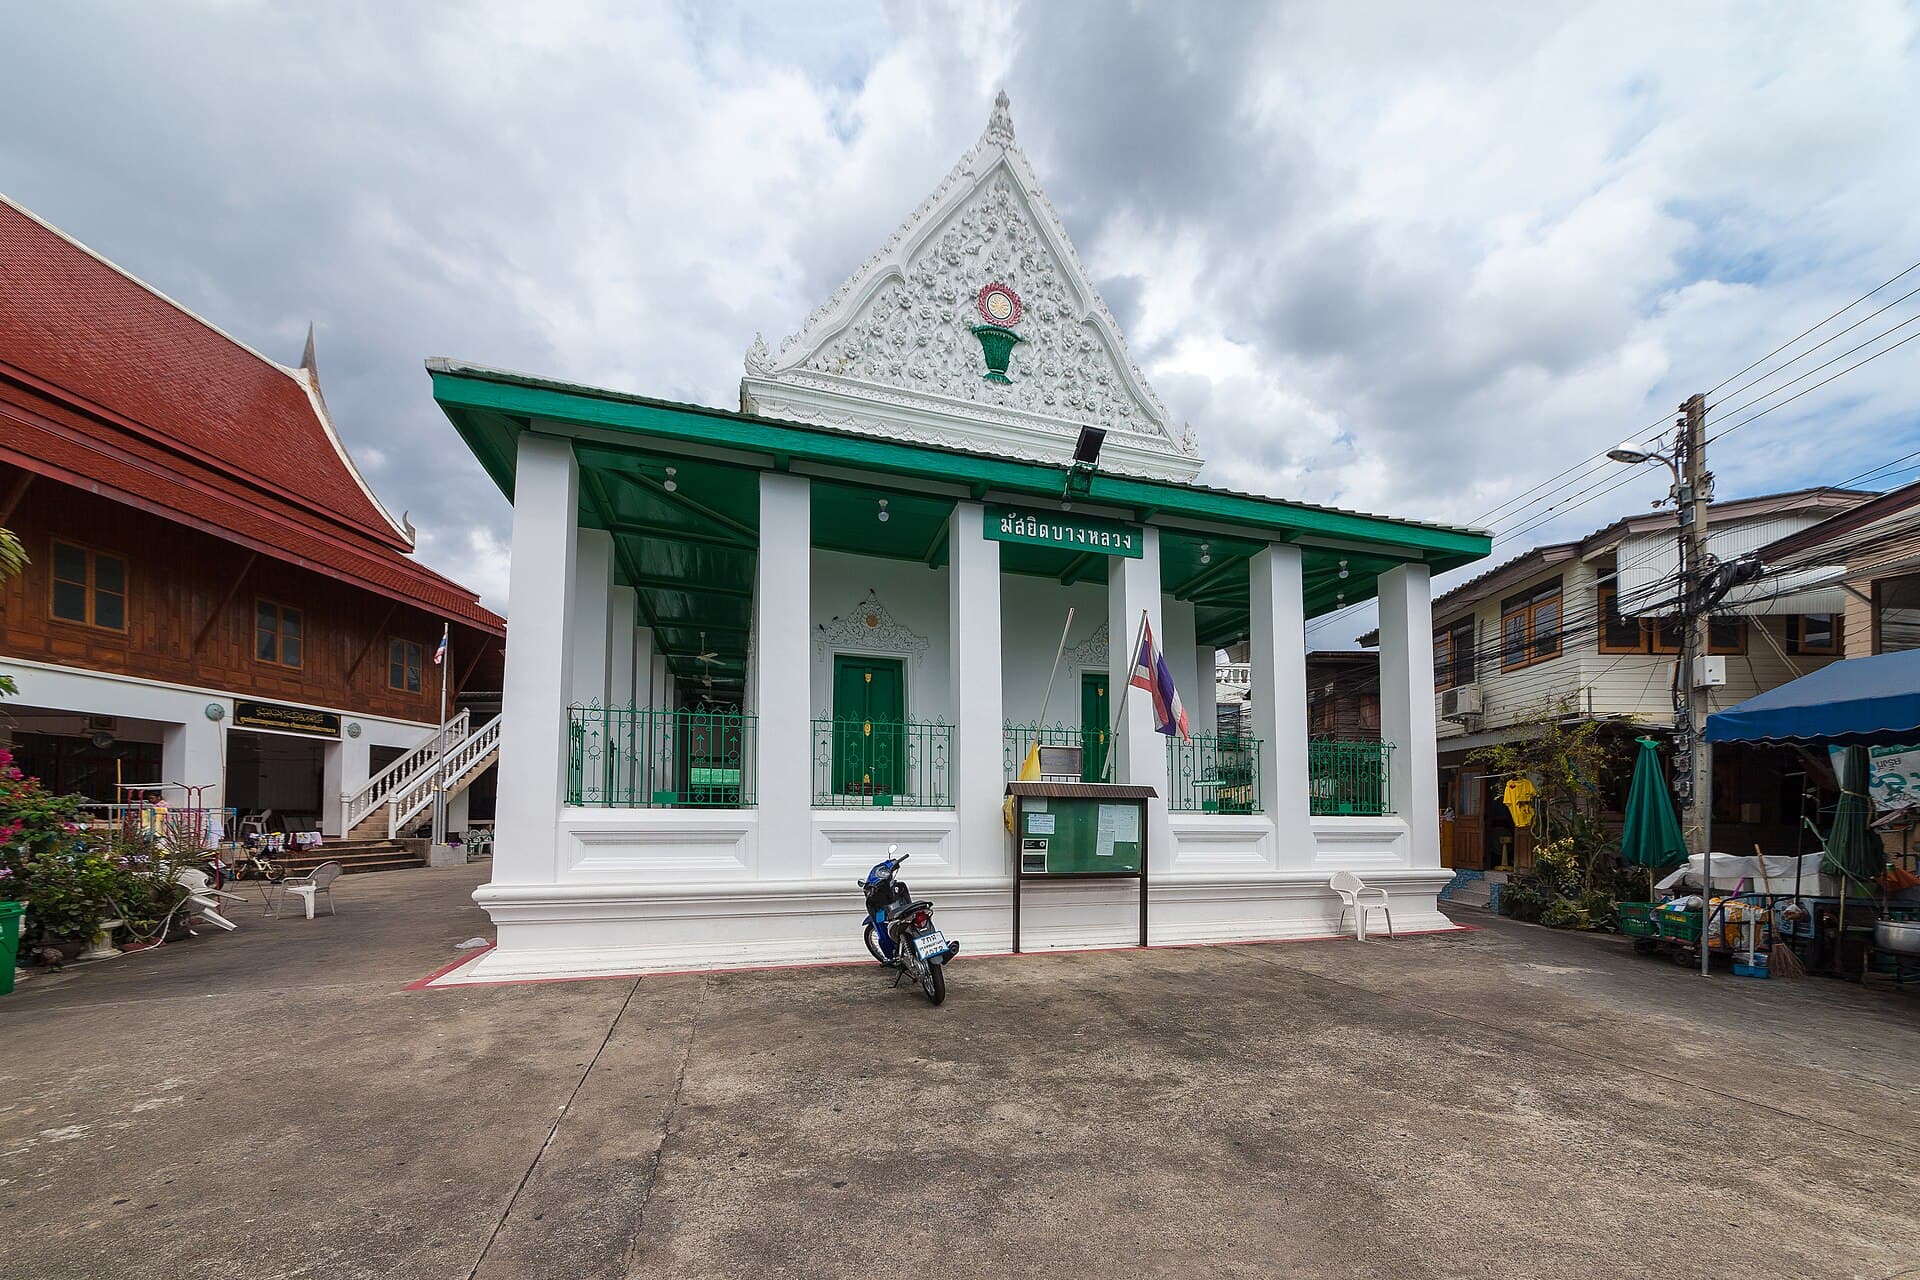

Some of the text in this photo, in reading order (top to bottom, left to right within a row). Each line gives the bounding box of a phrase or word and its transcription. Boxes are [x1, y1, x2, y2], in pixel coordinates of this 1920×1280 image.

[1000, 512, 1132, 550] มัสยิดบางหลวง
